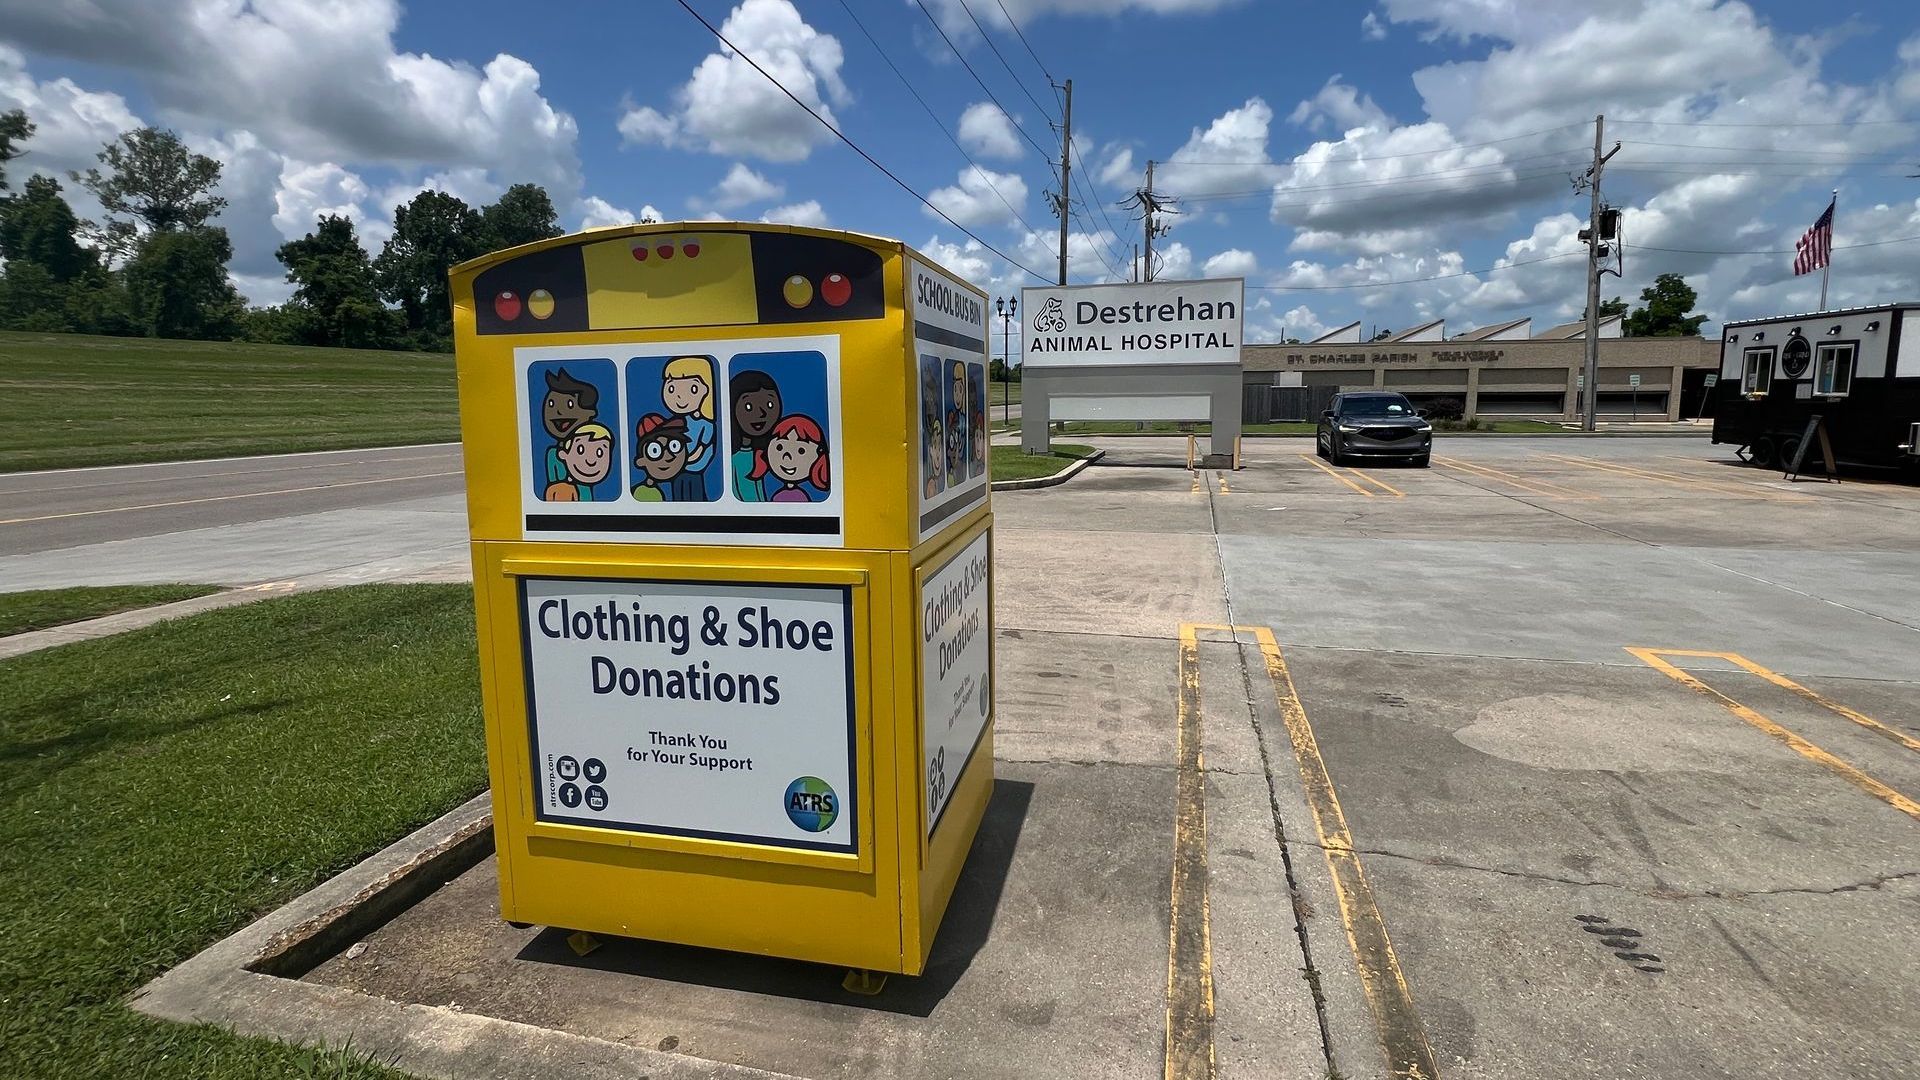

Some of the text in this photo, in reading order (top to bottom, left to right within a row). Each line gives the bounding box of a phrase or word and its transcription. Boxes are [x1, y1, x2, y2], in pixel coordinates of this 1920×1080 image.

[918, 273, 954, 316] SCHOOL
[954, 292, 969, 322] BUS
[1076, 296, 1235, 325] Destrehan
[1031, 332, 1234, 352] ANIMAL HOSPITAL
[924, 554, 987, 644] Clothing & Shoe
[538, 598, 834, 656] Clothing & Shoe
[939, 606, 979, 682] Donations
[591, 656, 780, 705] Donations
[627, 747, 753, 771] for Your Support
[649, 731, 727, 750] Thank You
[547, 754, 557, 808] atrscorp.com
[790, 792, 834, 813] ATRS
